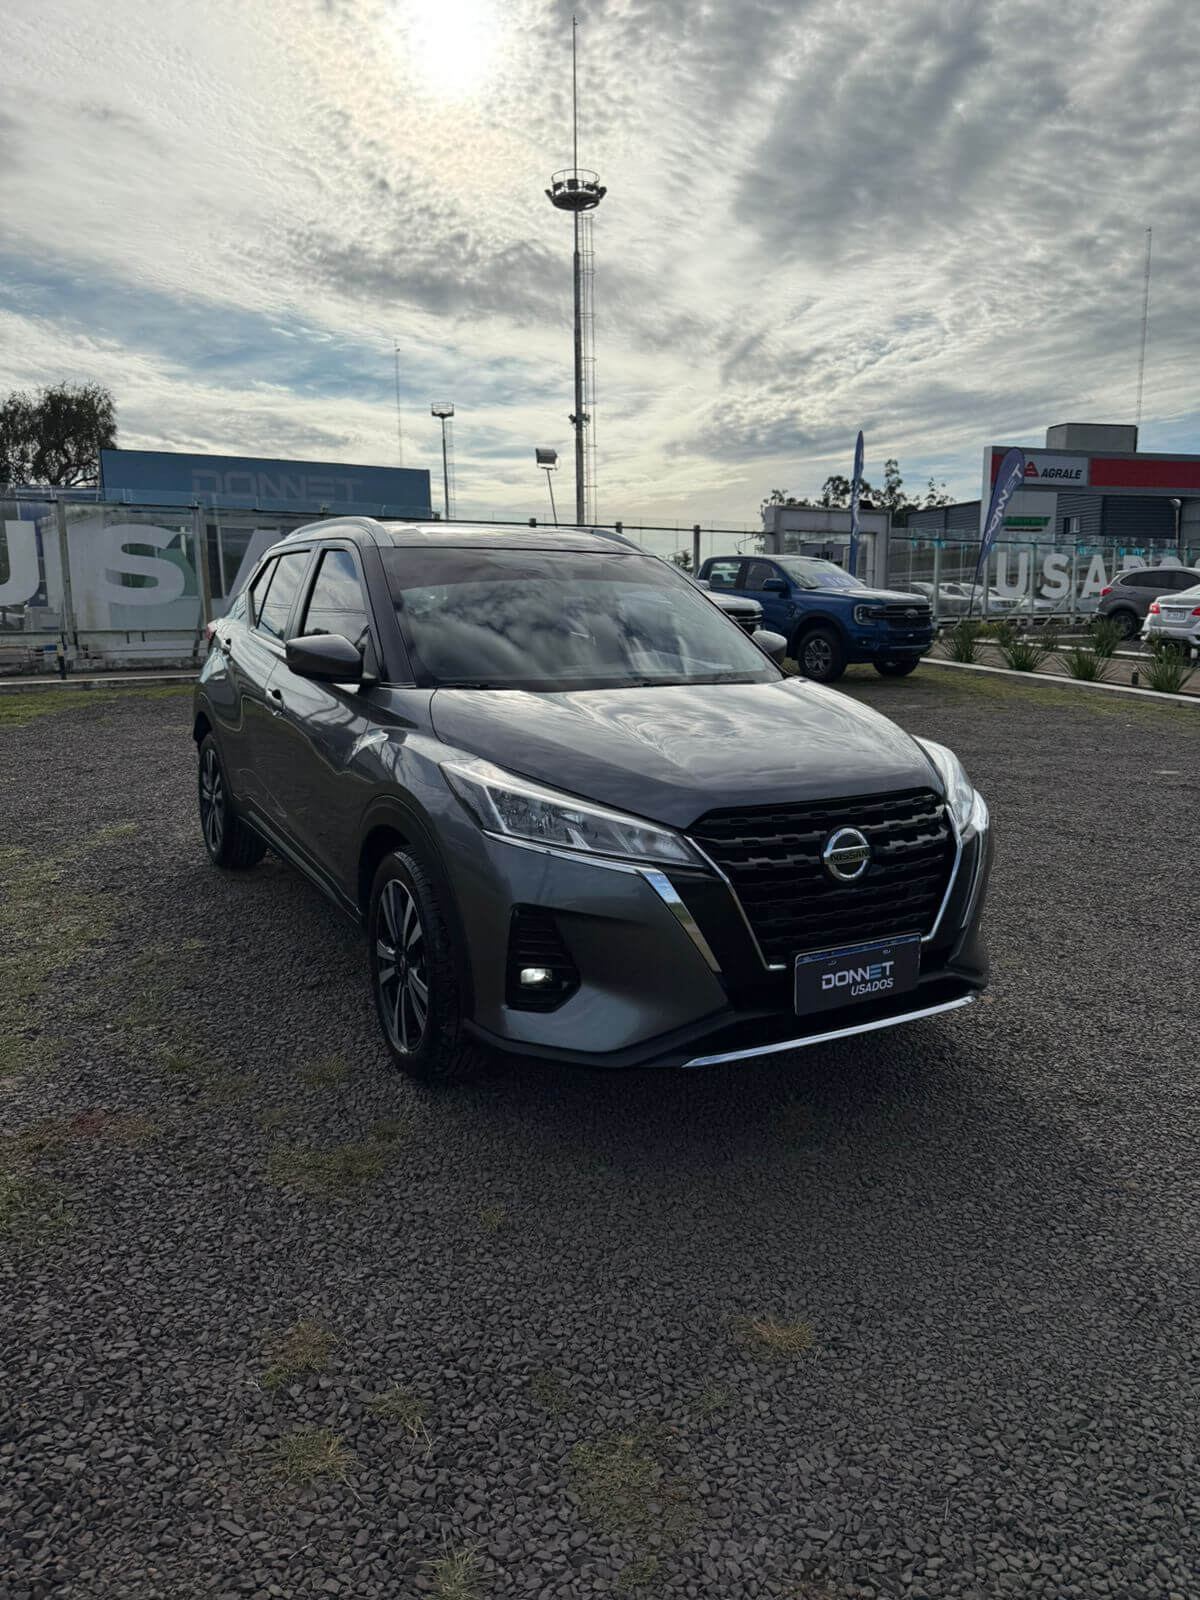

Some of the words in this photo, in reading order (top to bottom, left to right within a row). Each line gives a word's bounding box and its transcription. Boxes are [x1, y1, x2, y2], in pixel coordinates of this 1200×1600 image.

[1041, 468, 1082, 480] AGRALE
[192, 469, 361, 505] DONNET
[822, 961, 894, 990] DONNET
[851, 978, 894, 996] USADOS
